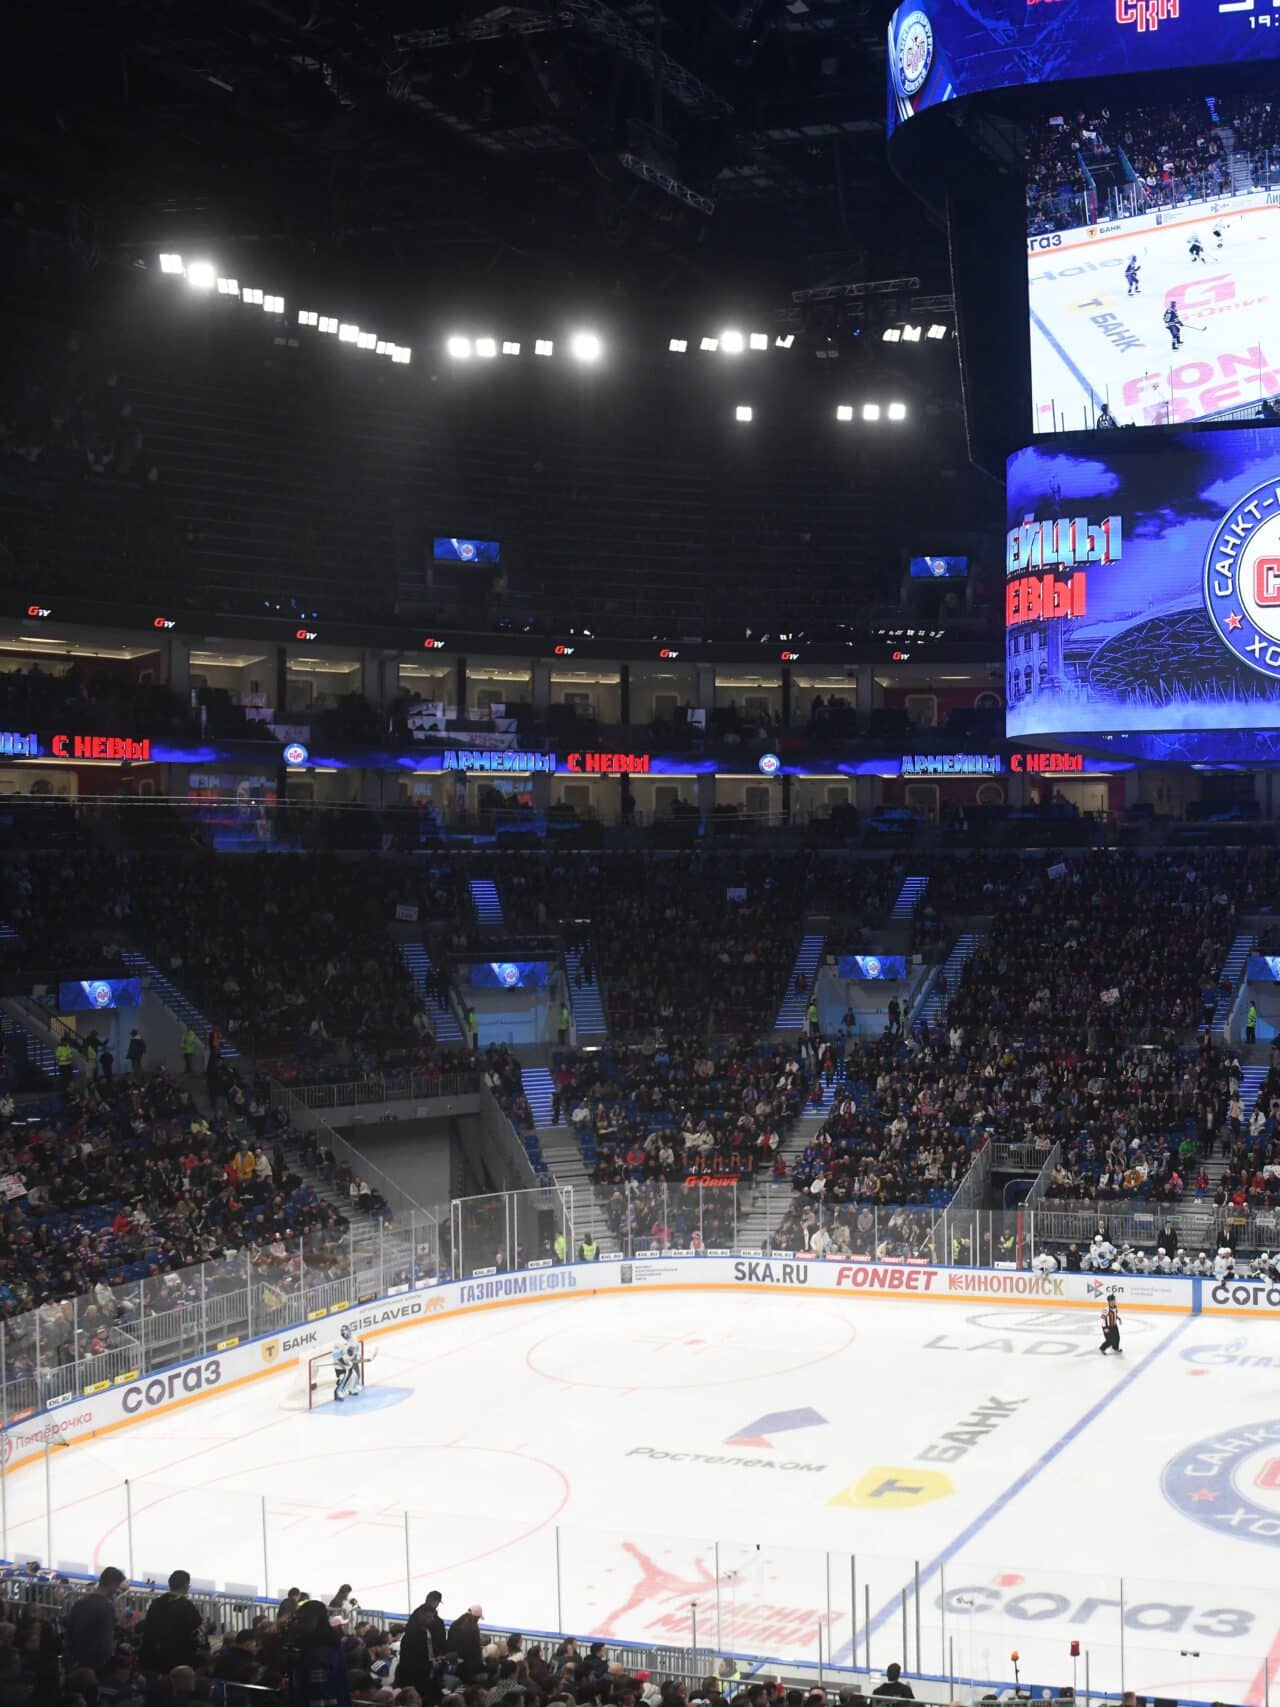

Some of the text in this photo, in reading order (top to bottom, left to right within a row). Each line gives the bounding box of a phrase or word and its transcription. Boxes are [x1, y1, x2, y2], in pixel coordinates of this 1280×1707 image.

[1122, 346, 1269, 407] FON
[73, 736, 151, 760] НЕВЫ
[443, 748, 557, 773] АРМЕЙЦЫ
[586, 752, 650, 773] НЕВЫ
[901, 751, 1001, 774] АРМЕЙЦЫ
[1026, 752, 1084, 773] НЕВЫ
[733, 1261, 809, 1284] SKA.RU
[836, 1266, 938, 1291] FONBET
[282, 1331, 318, 1353] БАНК
[914, 1395, 1032, 1465] БАНК
[624, 1446, 830, 1474] Ростелеком
